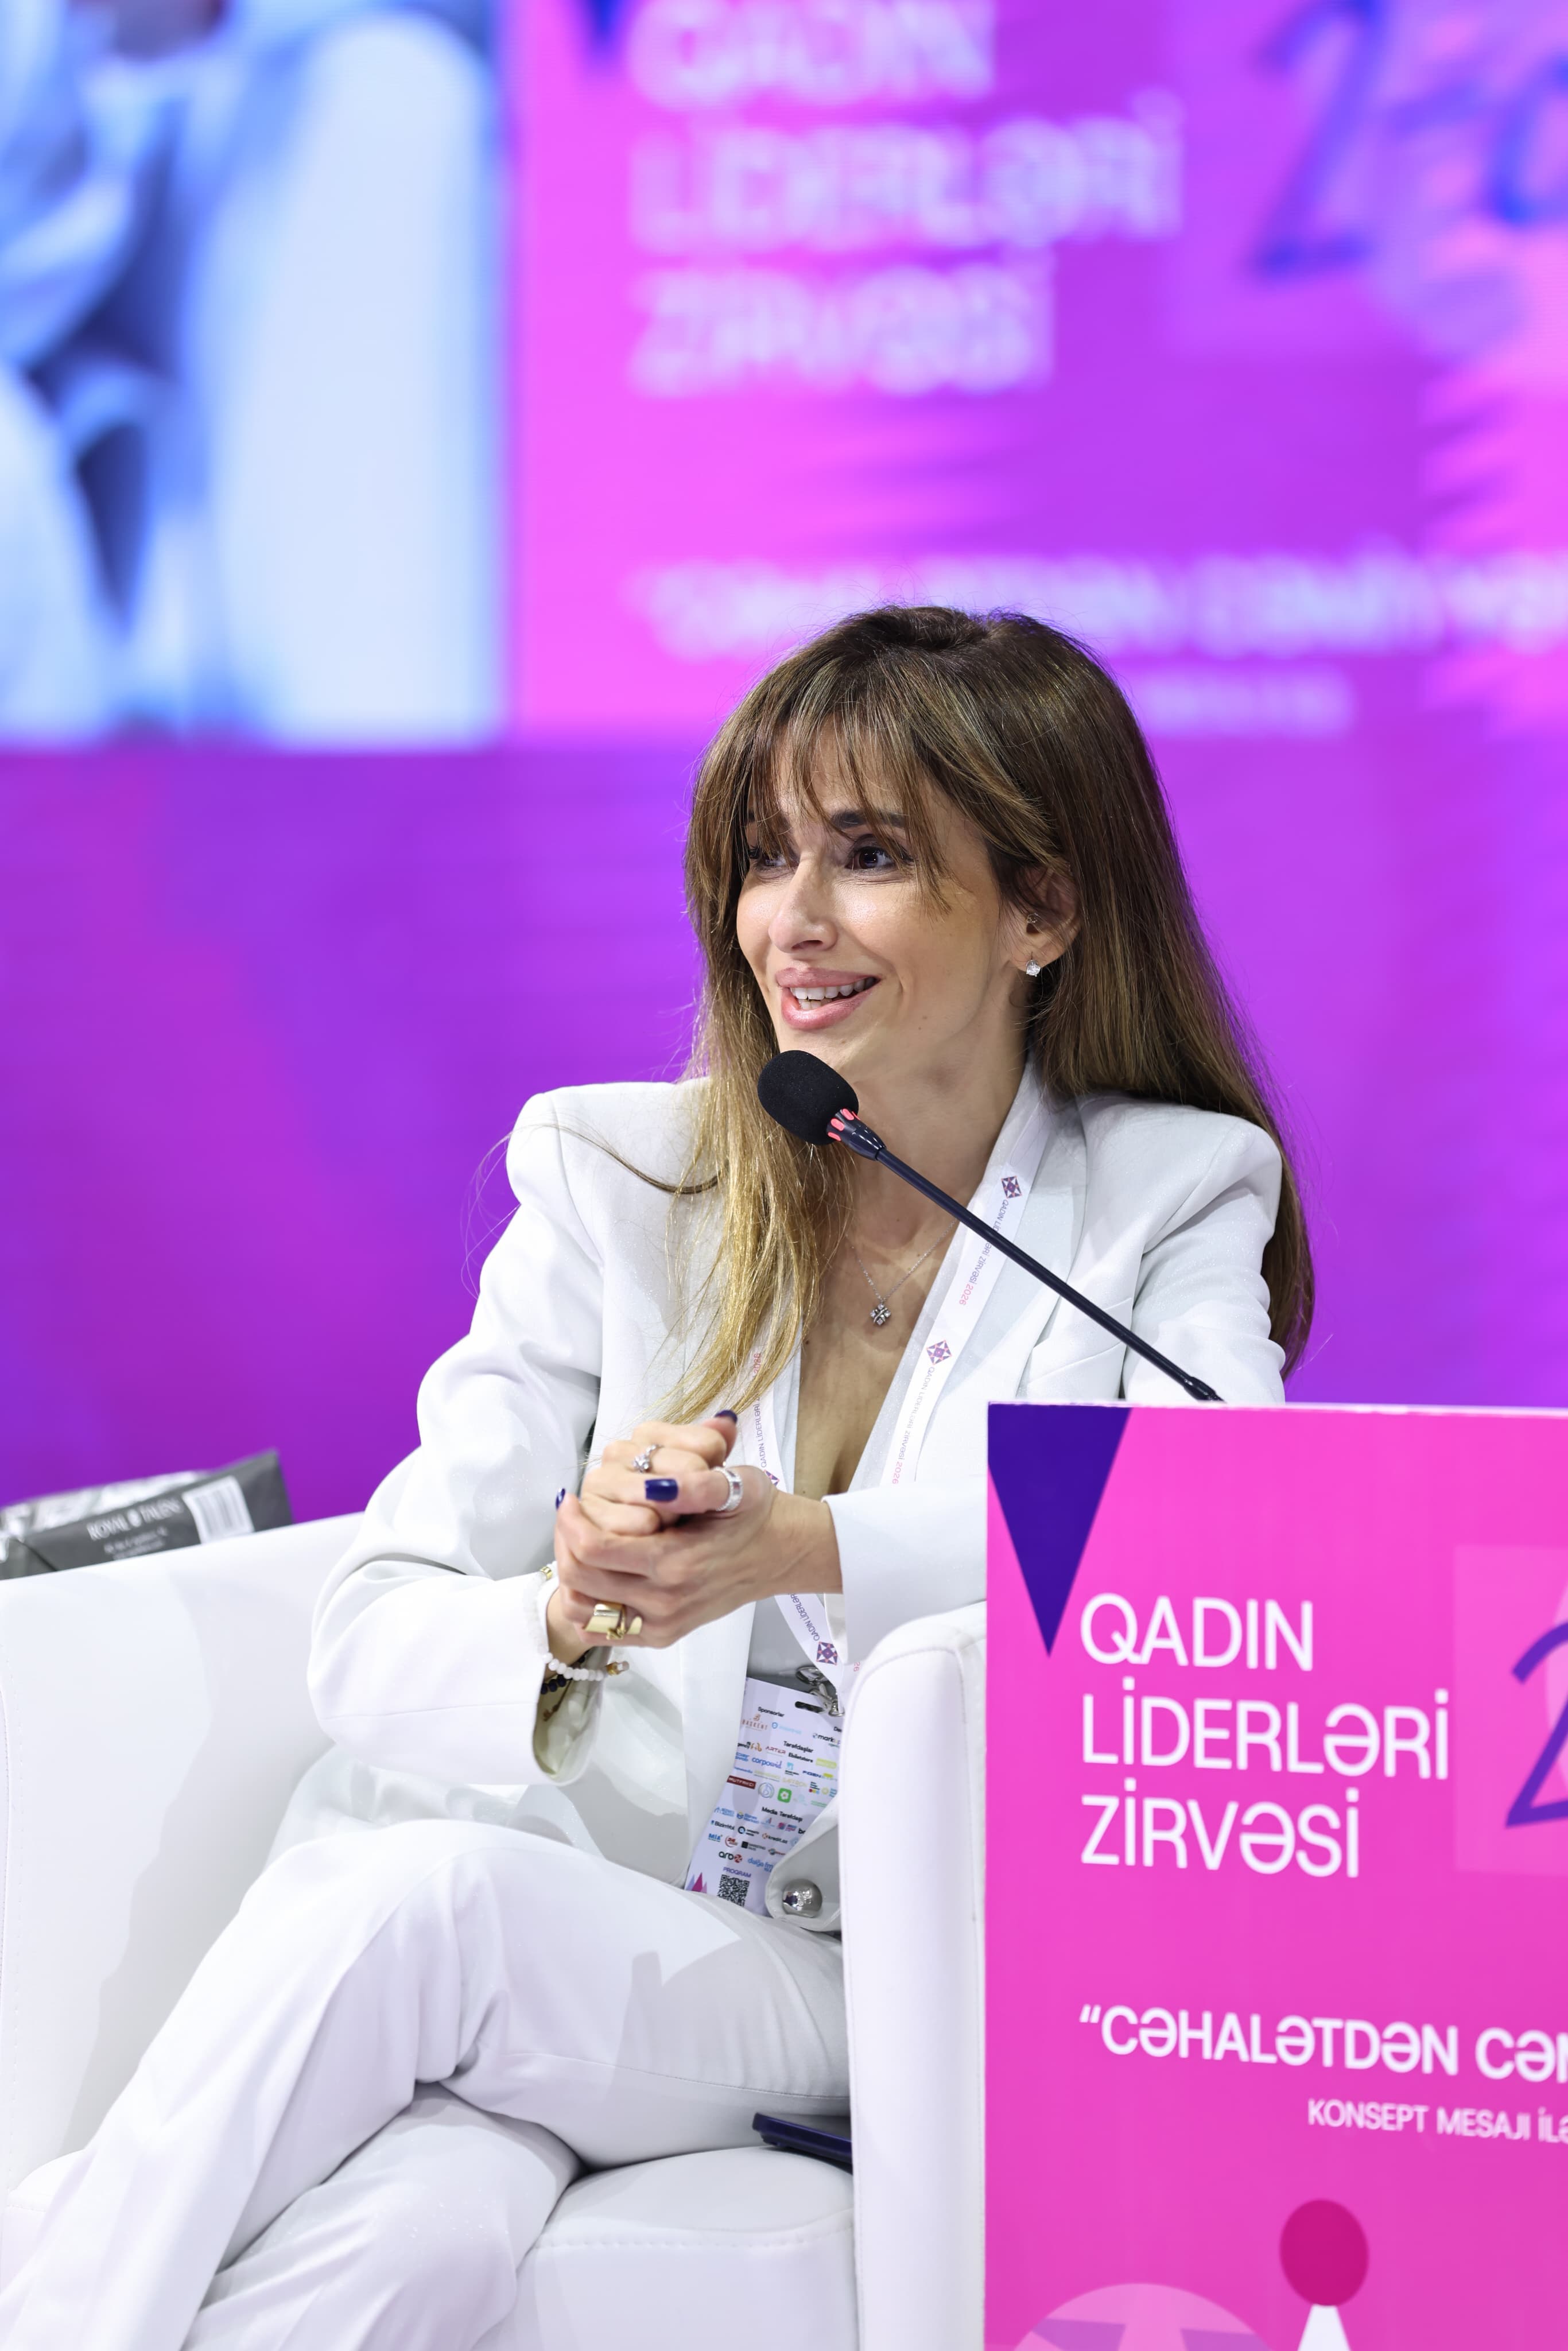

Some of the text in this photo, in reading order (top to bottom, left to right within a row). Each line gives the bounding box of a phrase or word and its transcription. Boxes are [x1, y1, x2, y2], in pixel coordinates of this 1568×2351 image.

[997, 1200, 1009, 1221] QADIN
[968, 1256, 986, 1285] ZİRVƏSİ
[959, 1284, 973, 1306] 2026
[758, 1443, 767, 1468] QADIN
[892, 1461, 902, 1484] 2026
[789, 1593, 820, 1641] QADIN LİDERLƏR
[1080, 1593, 1314, 1671] QADIN
[1082, 1676, 1449, 1780] LİDERLƏRİ
[762, 1806, 778, 1815] Media
[1080, 1777, 1359, 1878] ZİRVƏSİ
[1079, 2004, 1458, 2076] “CƏHALƏTDƏN
[1308, 2098, 1429, 2133] KONSEPT
[1437, 2106, 1531, 2140] MESAJI
